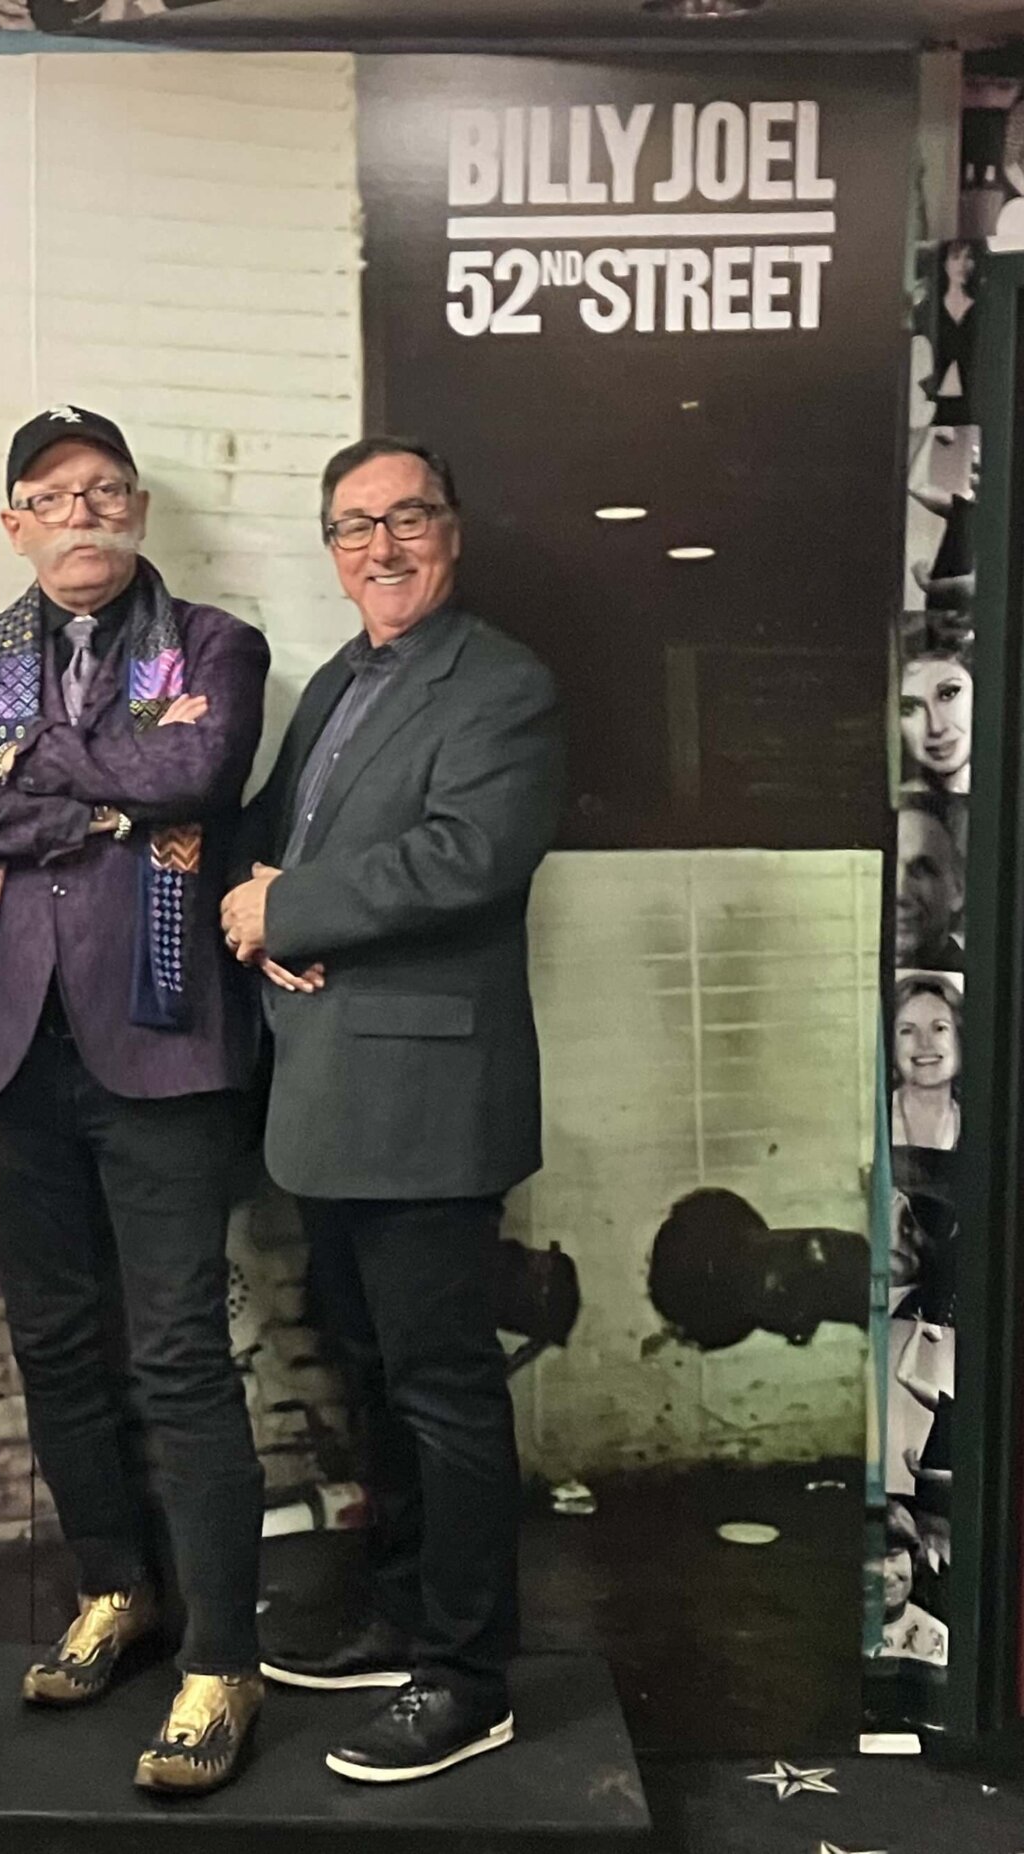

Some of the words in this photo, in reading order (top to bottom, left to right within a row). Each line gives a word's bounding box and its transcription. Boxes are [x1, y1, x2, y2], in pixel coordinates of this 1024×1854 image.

[448, 103, 654, 206] BILLY
[653, 100, 836, 203] JOEL
[446, 247, 583, 336] 52ND
[579, 245, 833, 333] STREET
